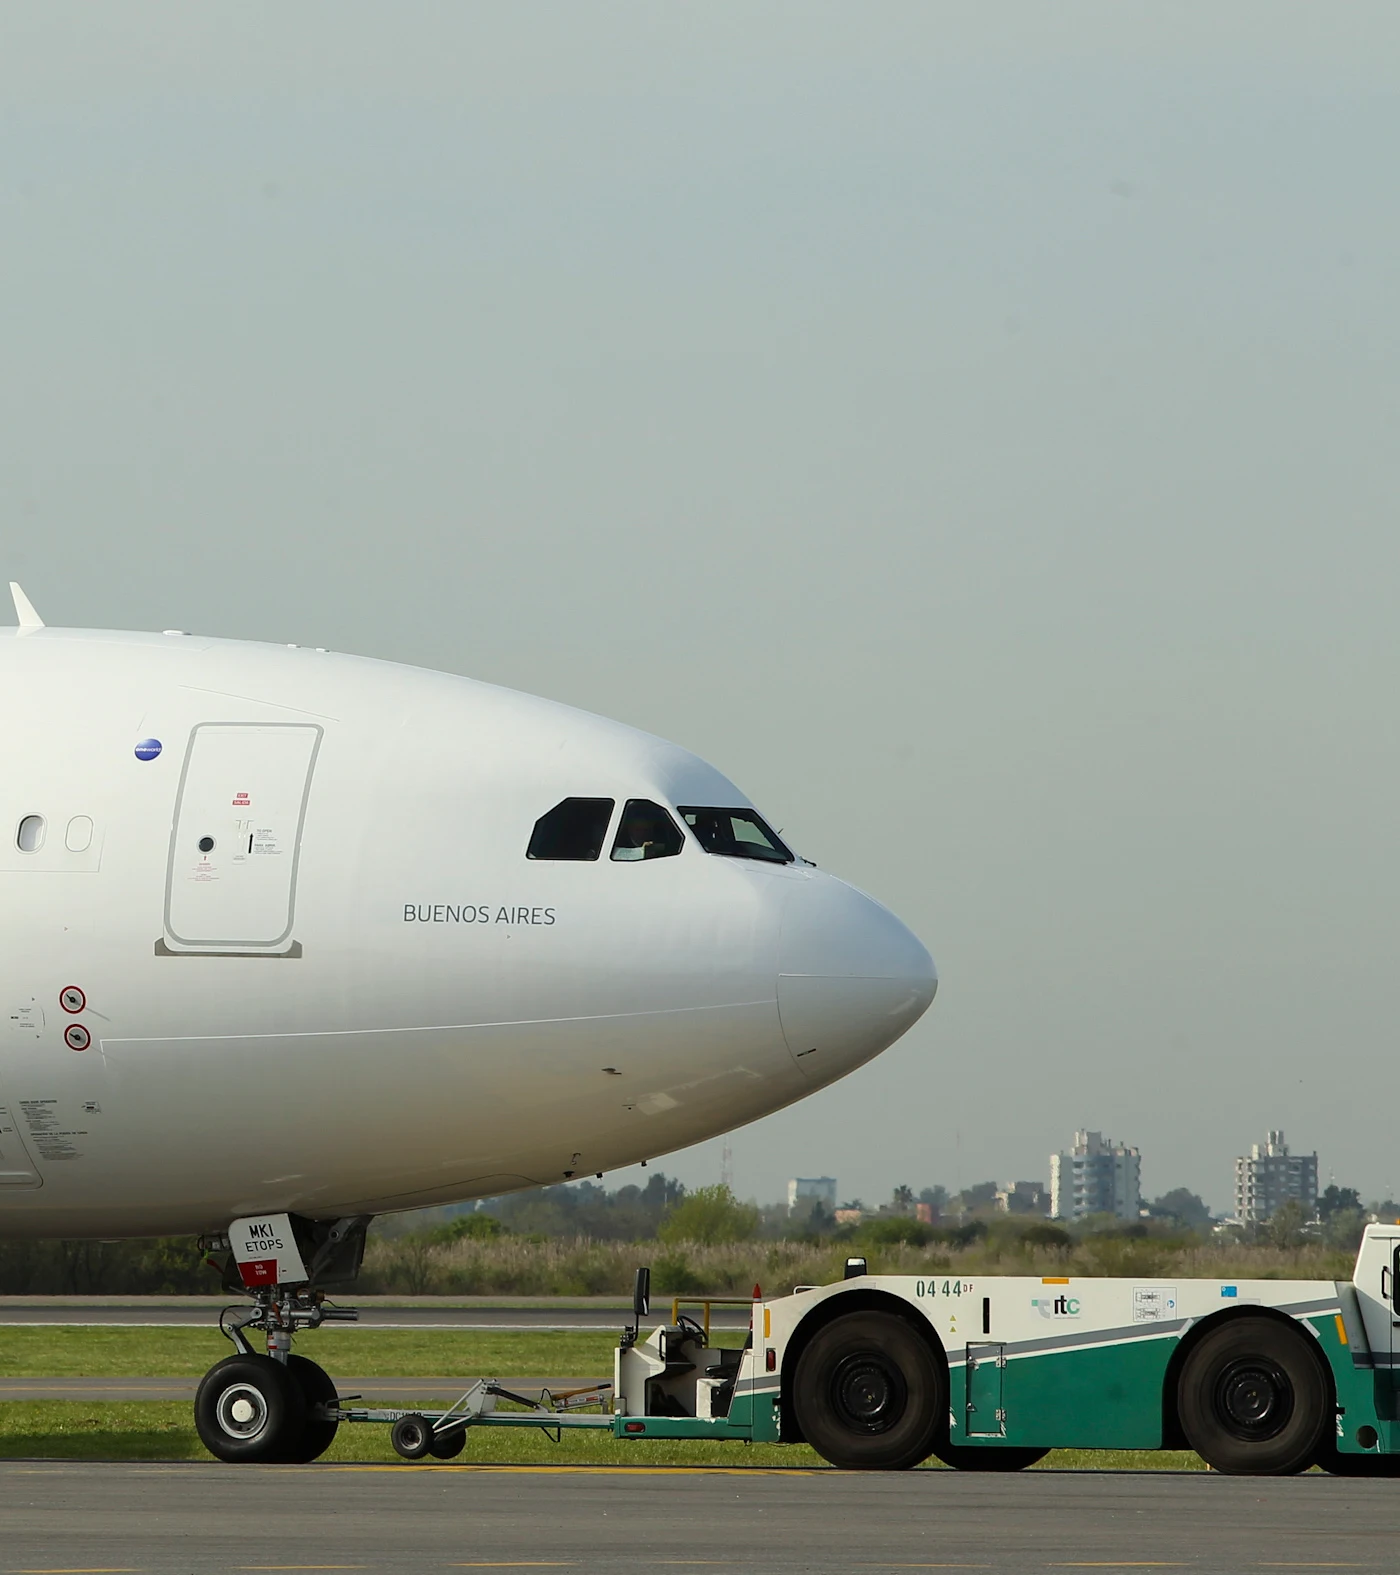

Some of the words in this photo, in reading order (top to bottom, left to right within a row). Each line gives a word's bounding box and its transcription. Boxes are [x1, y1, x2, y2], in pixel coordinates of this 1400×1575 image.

[403, 904, 490, 924] BUENOS
[495, 906, 556, 926] AIRES
[245, 1238, 283, 1252] ETOPS
